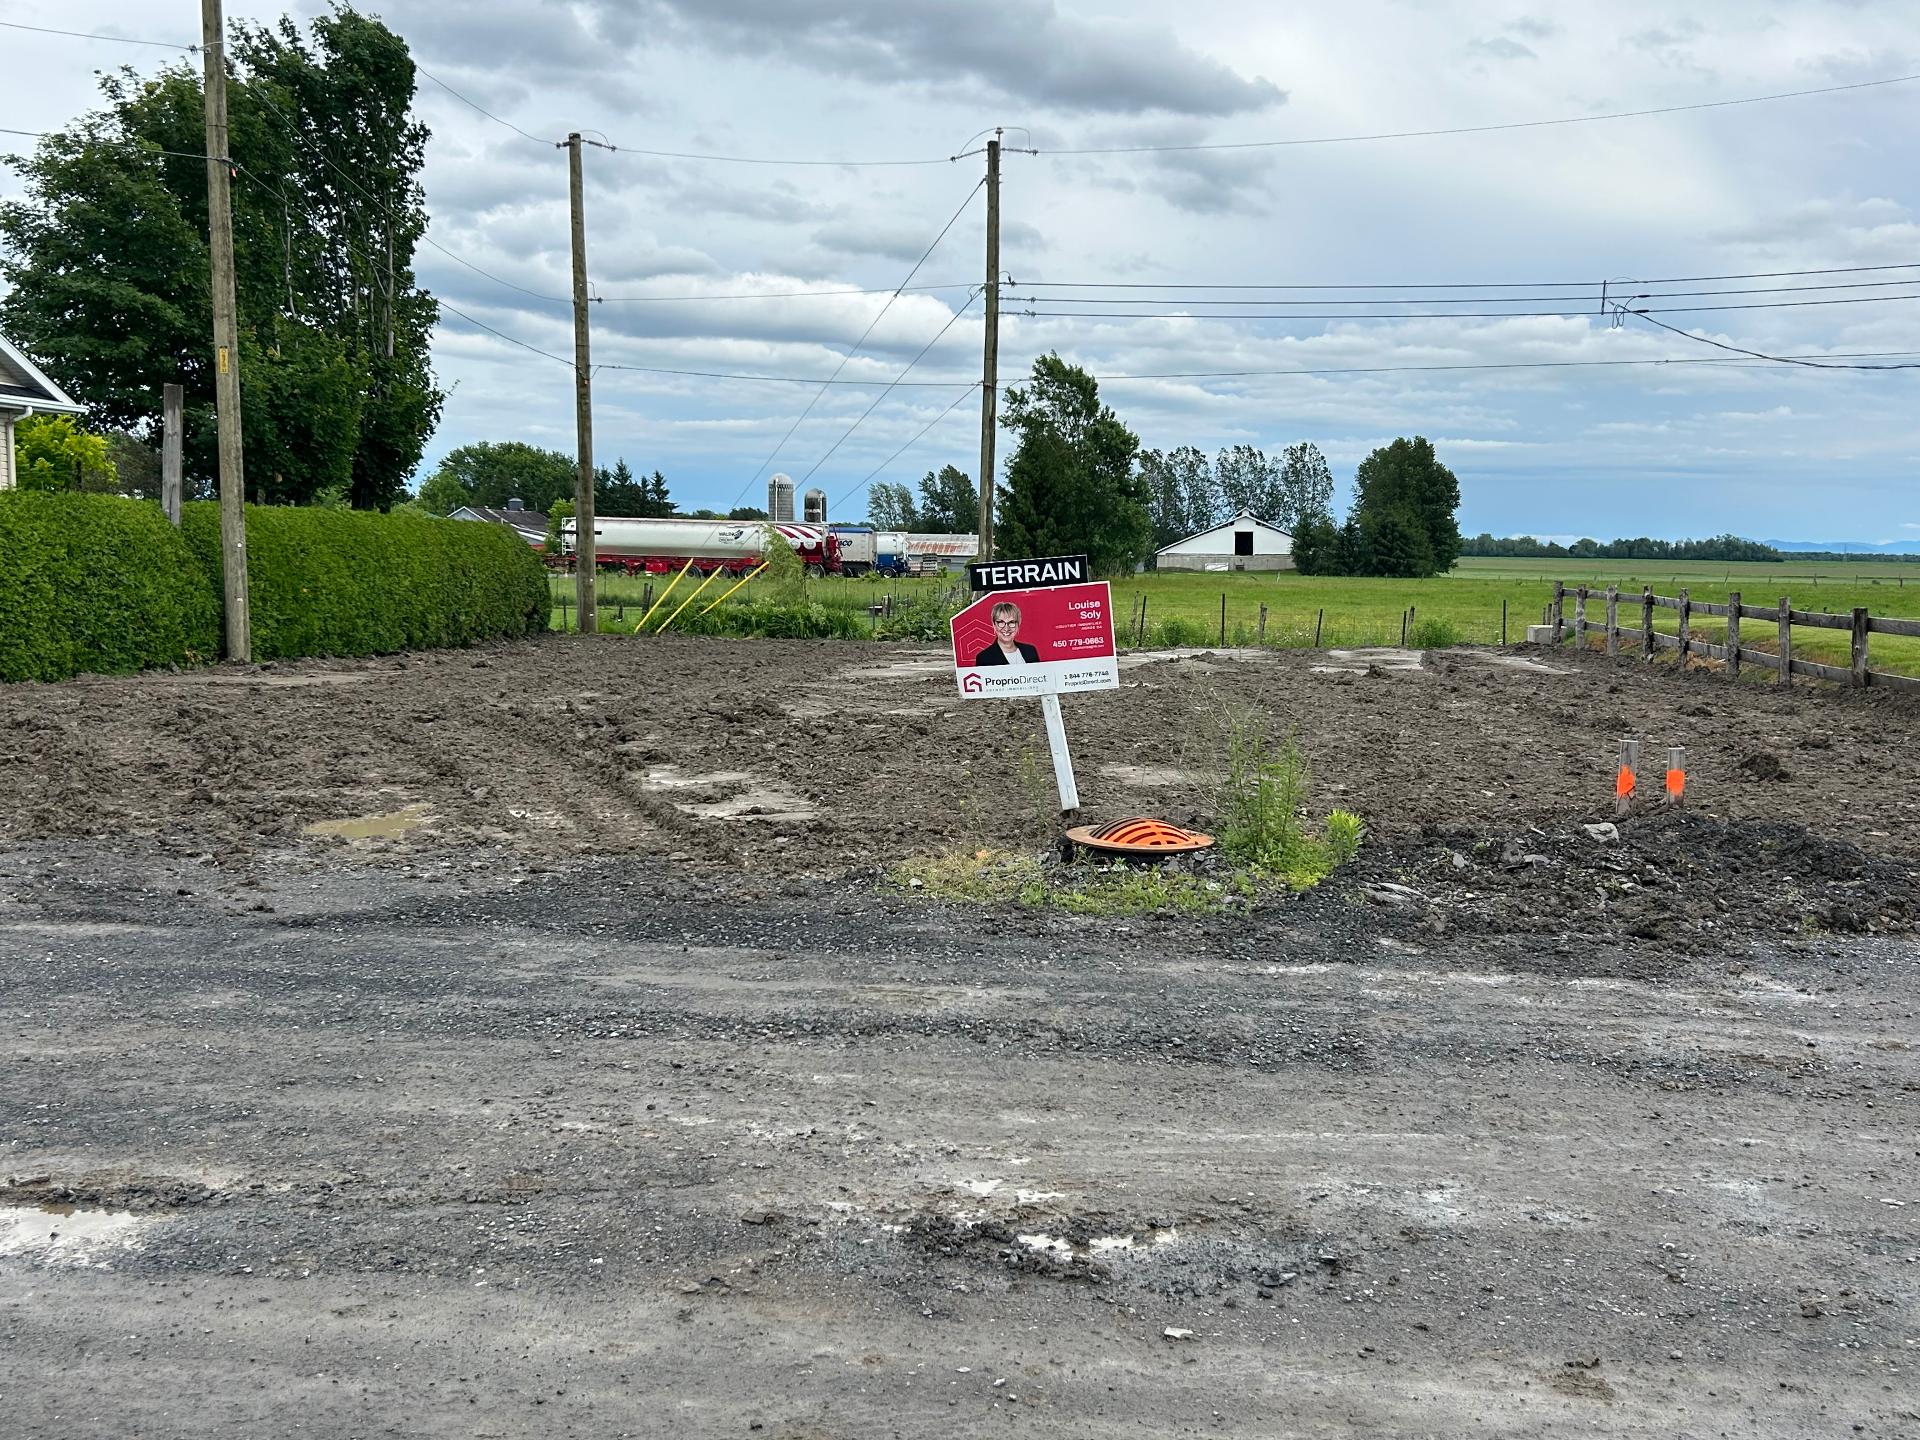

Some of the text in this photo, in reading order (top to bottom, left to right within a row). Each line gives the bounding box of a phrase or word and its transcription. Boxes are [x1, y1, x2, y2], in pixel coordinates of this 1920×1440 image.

[976, 561, 1081, 586] TERRAIN
[1068, 599, 1101, 611] Louise
[1080, 610, 1102, 620] Soly
[1052, 640, 1067, 648] 450
[985, 674, 1047, 687] ProprioDirect
